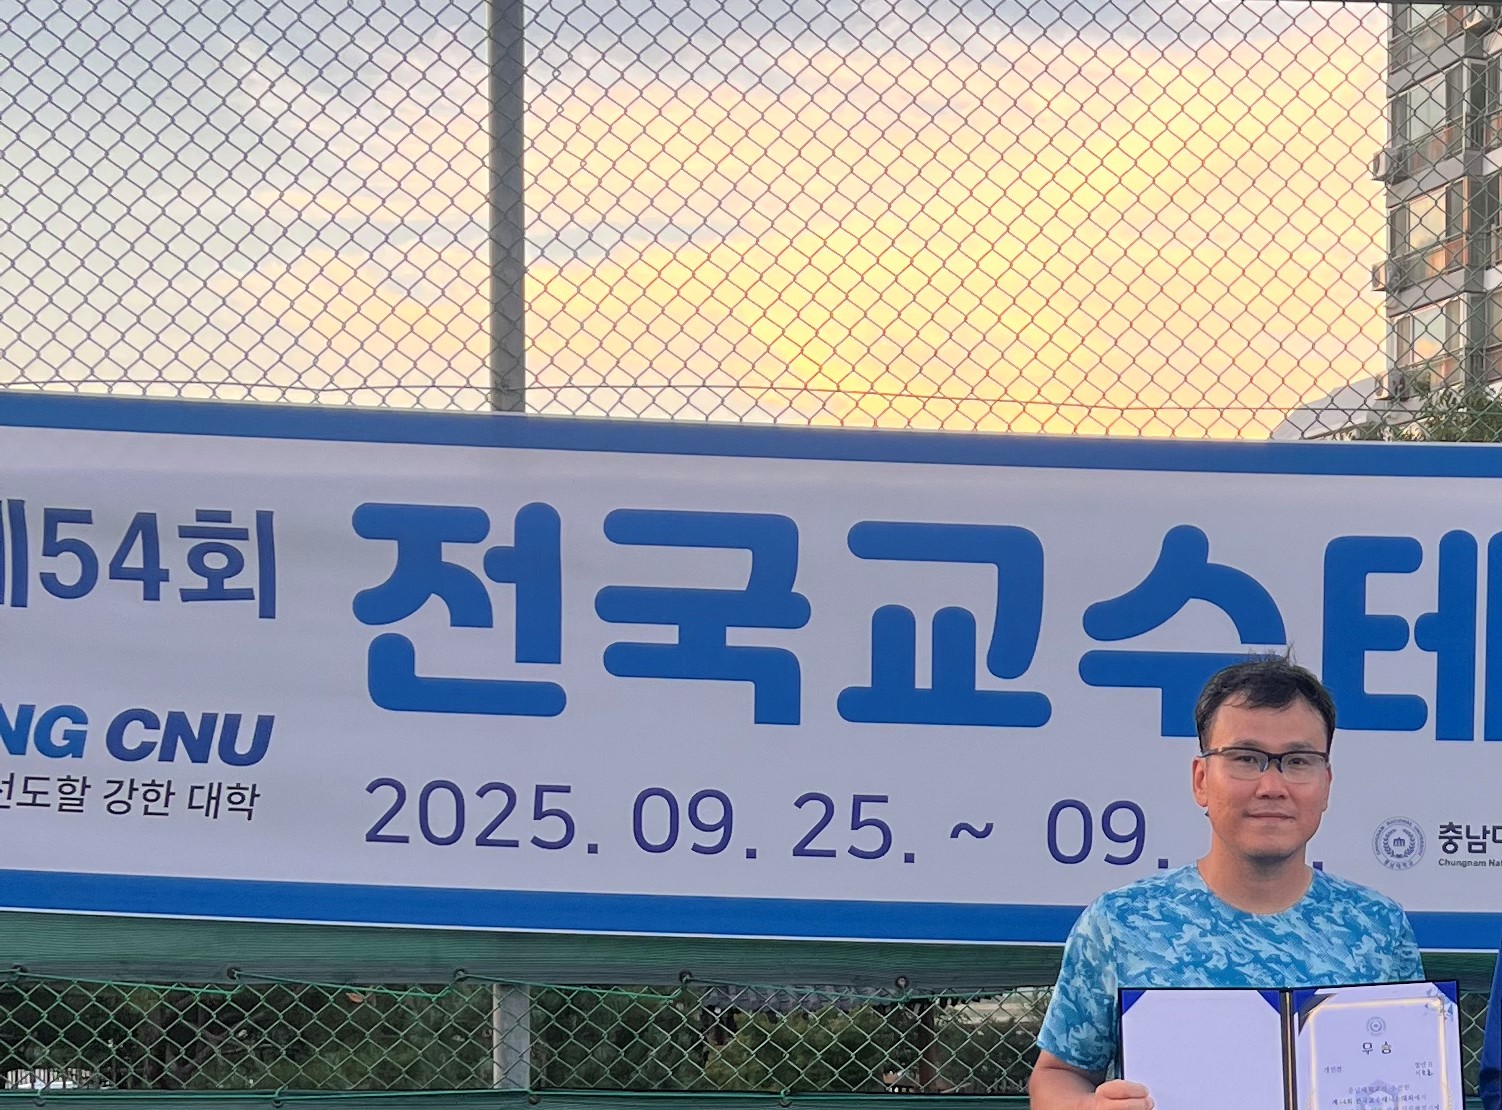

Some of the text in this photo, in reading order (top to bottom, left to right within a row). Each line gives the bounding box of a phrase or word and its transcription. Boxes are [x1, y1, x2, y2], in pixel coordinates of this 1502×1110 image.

[106, 708, 275, 767] CNU
[103, 777, 176, 817] 강한
[187, 781, 261, 821] 대학
[365, 777, 599, 855] 2025.
[632, 787, 757, 860] 09.
[792, 791, 915, 864] 25.
[1046, 798, 1169, 869] 09.
[1438, 858, 1487, 868] Chungnam
